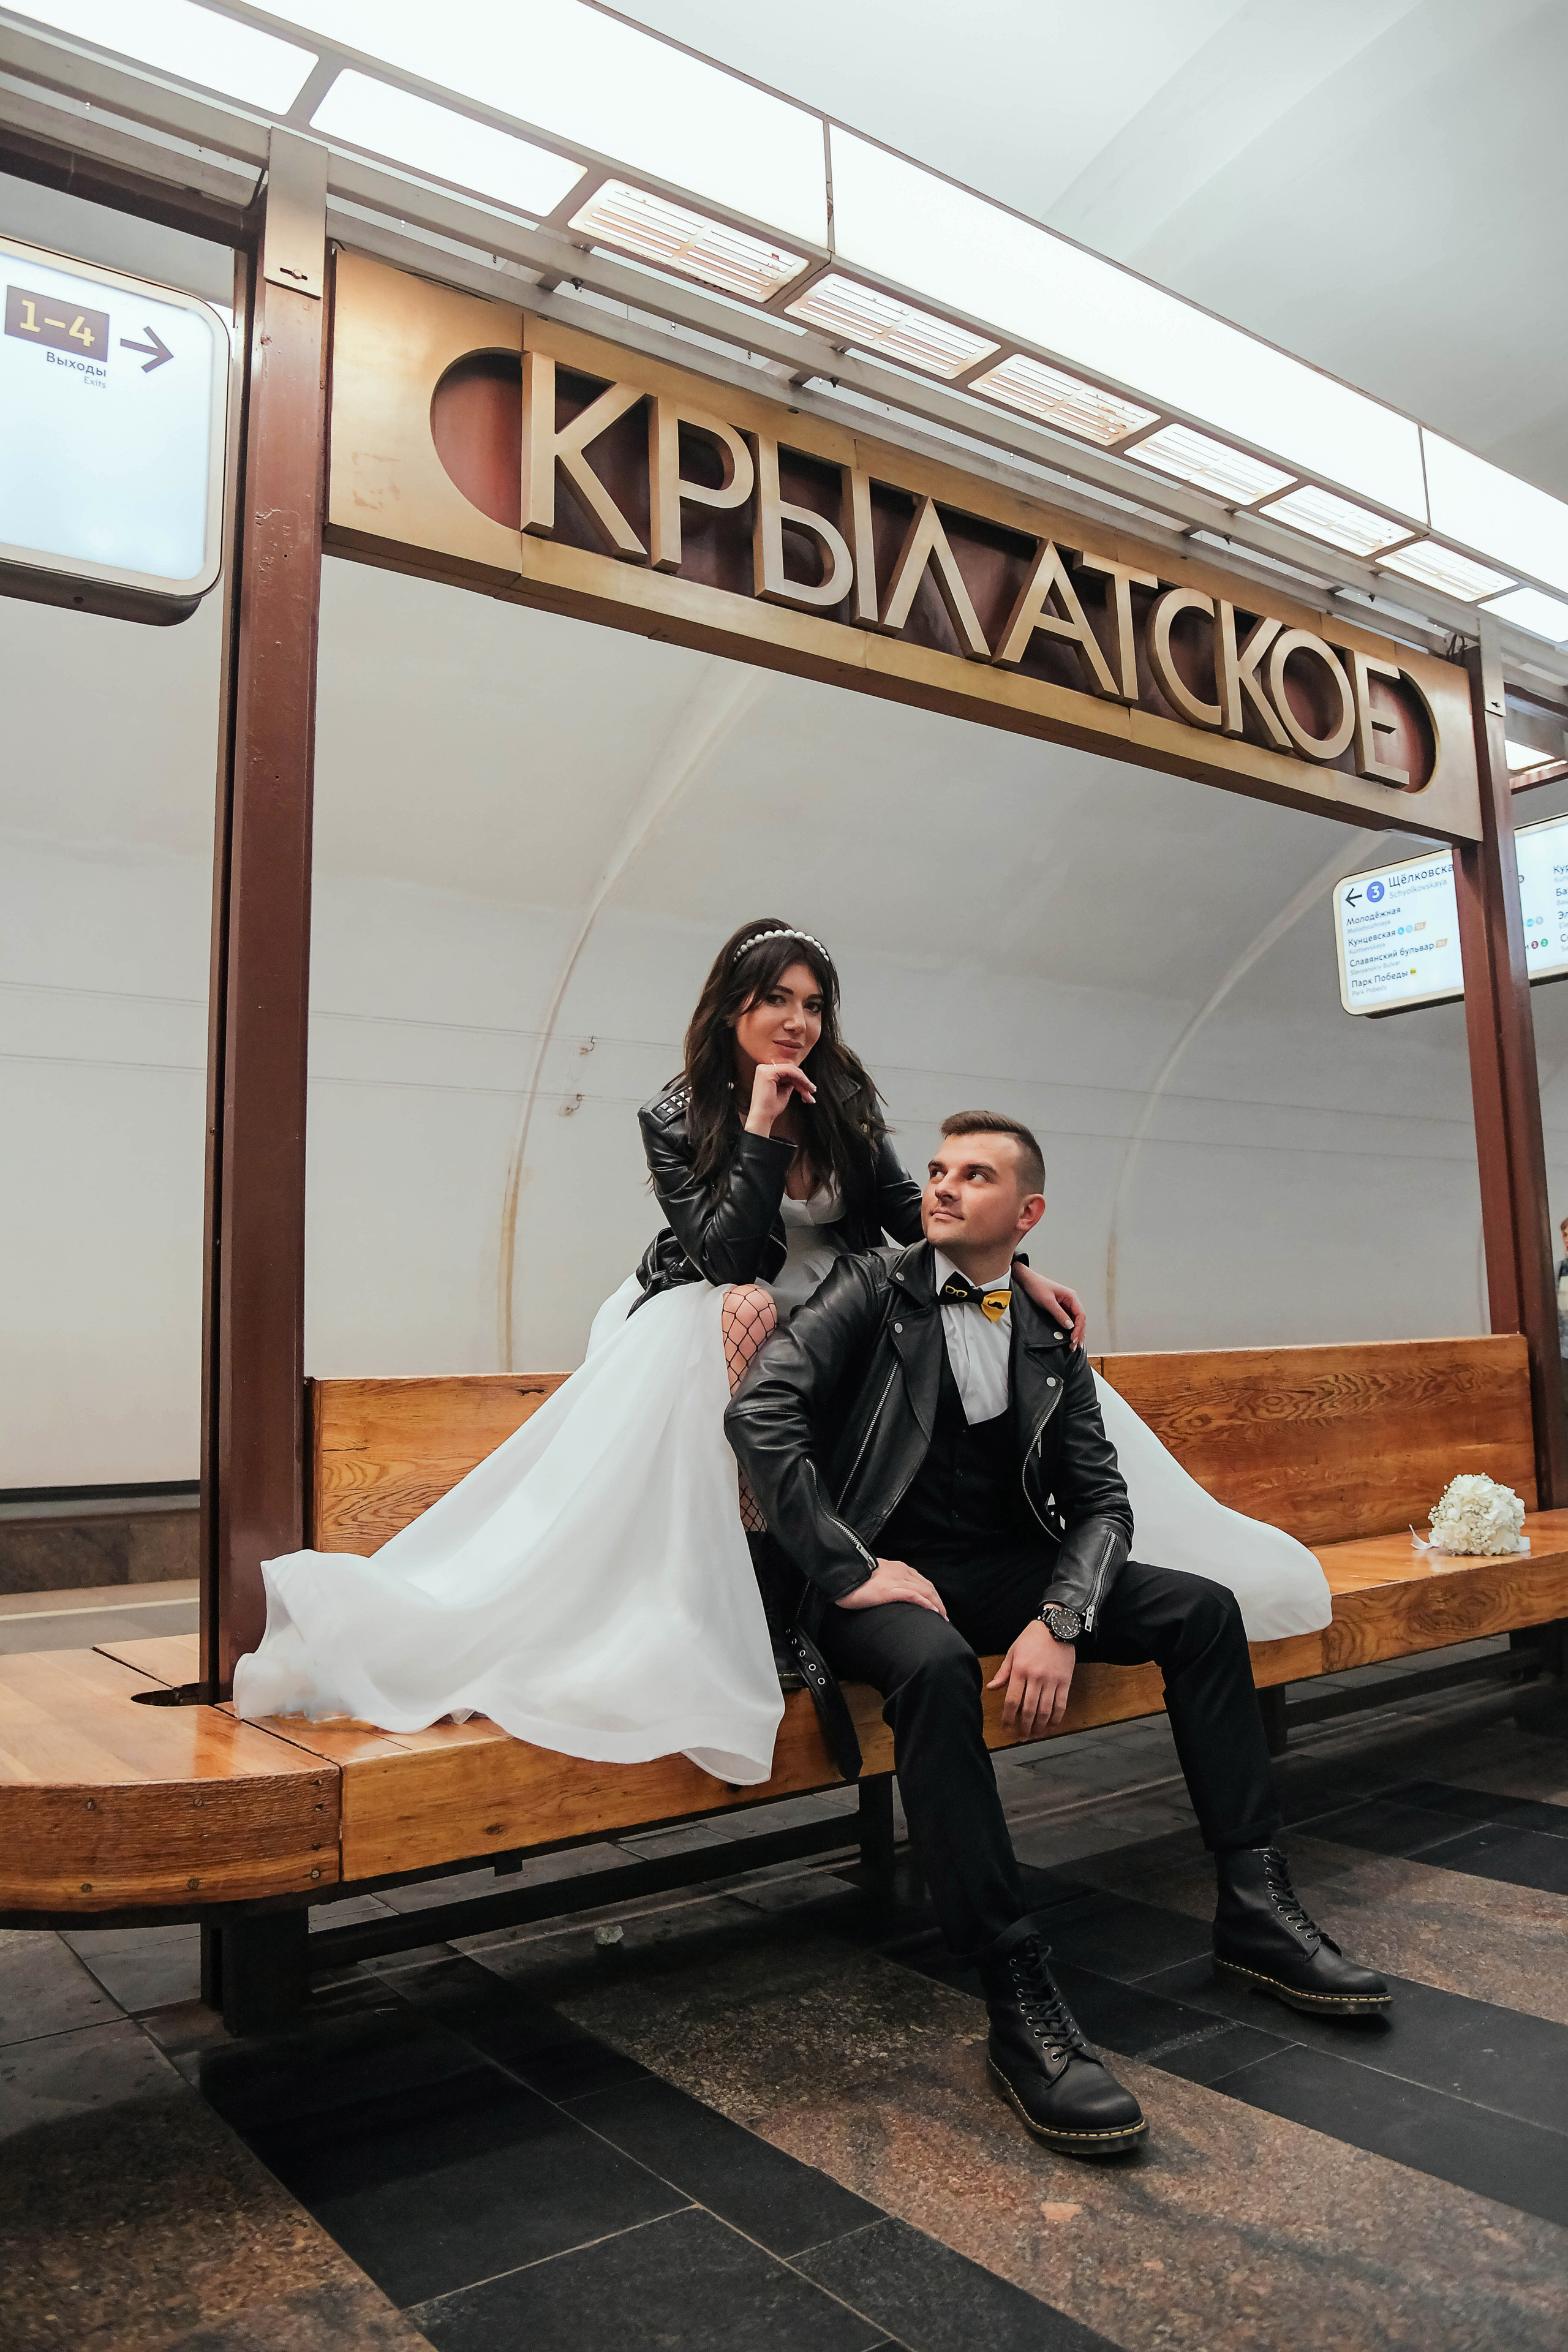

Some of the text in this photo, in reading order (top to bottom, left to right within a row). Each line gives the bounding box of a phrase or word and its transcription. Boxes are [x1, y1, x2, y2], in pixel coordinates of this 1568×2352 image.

[46, 351, 107, 377] Выходы
[83, 375, 107, 389] Exits
[522, 351, 1411, 788] КРЫЛАТСКОЕ
[1370, 864, 1454, 900] 3 Щёлковска
[1346, 907, 1401, 926] Молодёжная
[1348, 930, 1396, 948] Кунцевская
[1349, 950, 1398, 967] Славянский
[1400, 943, 1434, 957] бульвар
[1352, 976, 1373, 988] Парк
[1374, 970, 1408, 983] Победы
